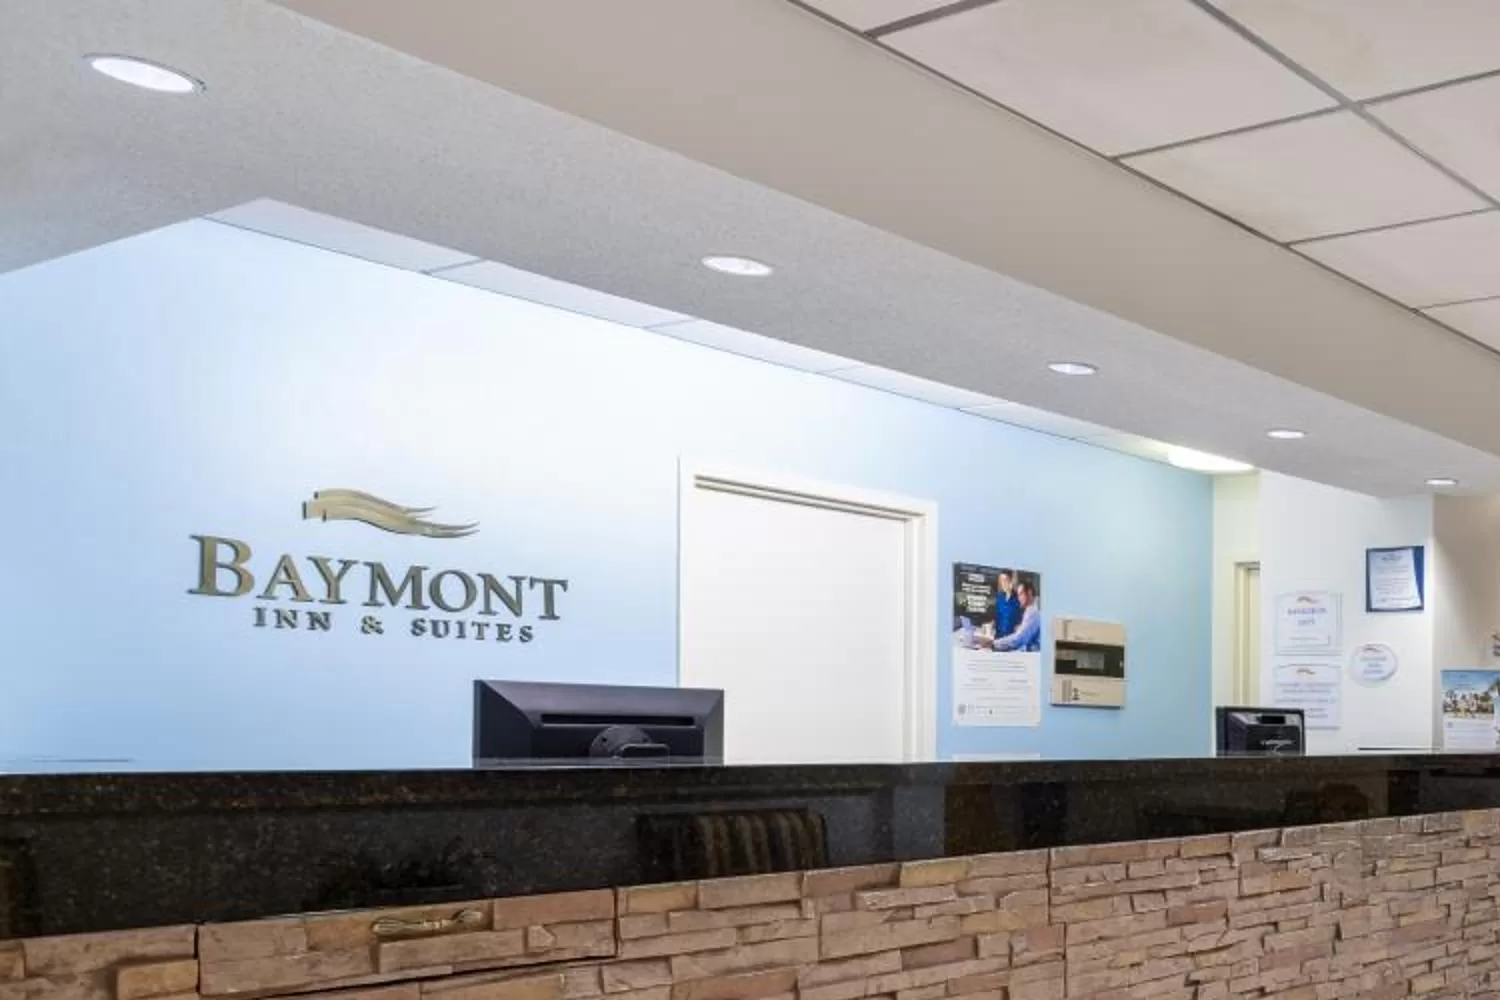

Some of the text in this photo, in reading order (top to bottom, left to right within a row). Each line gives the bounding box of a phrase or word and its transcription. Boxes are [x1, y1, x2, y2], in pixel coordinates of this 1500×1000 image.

[186, 534, 569, 620] BAYMONT
[251, 606, 535, 643] INN & SUITES
